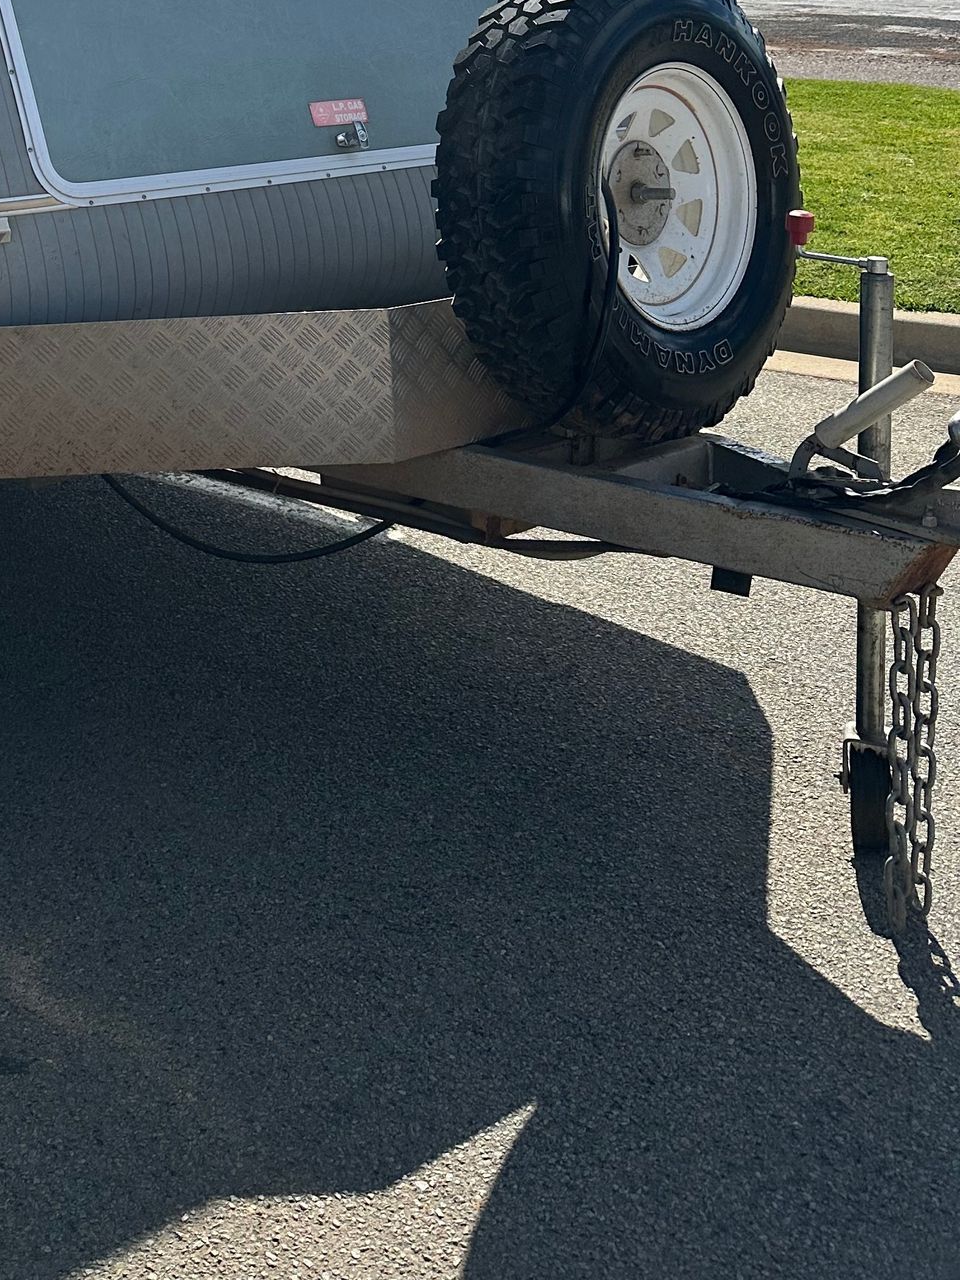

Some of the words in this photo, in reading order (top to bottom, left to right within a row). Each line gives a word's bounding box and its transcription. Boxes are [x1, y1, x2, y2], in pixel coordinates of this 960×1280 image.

[673, 19, 789, 179] HANKOOK
[332, 102, 347, 112] L.P.
[347, 100, 364, 110] GAS
[334, 111, 368, 123] STORAGE
